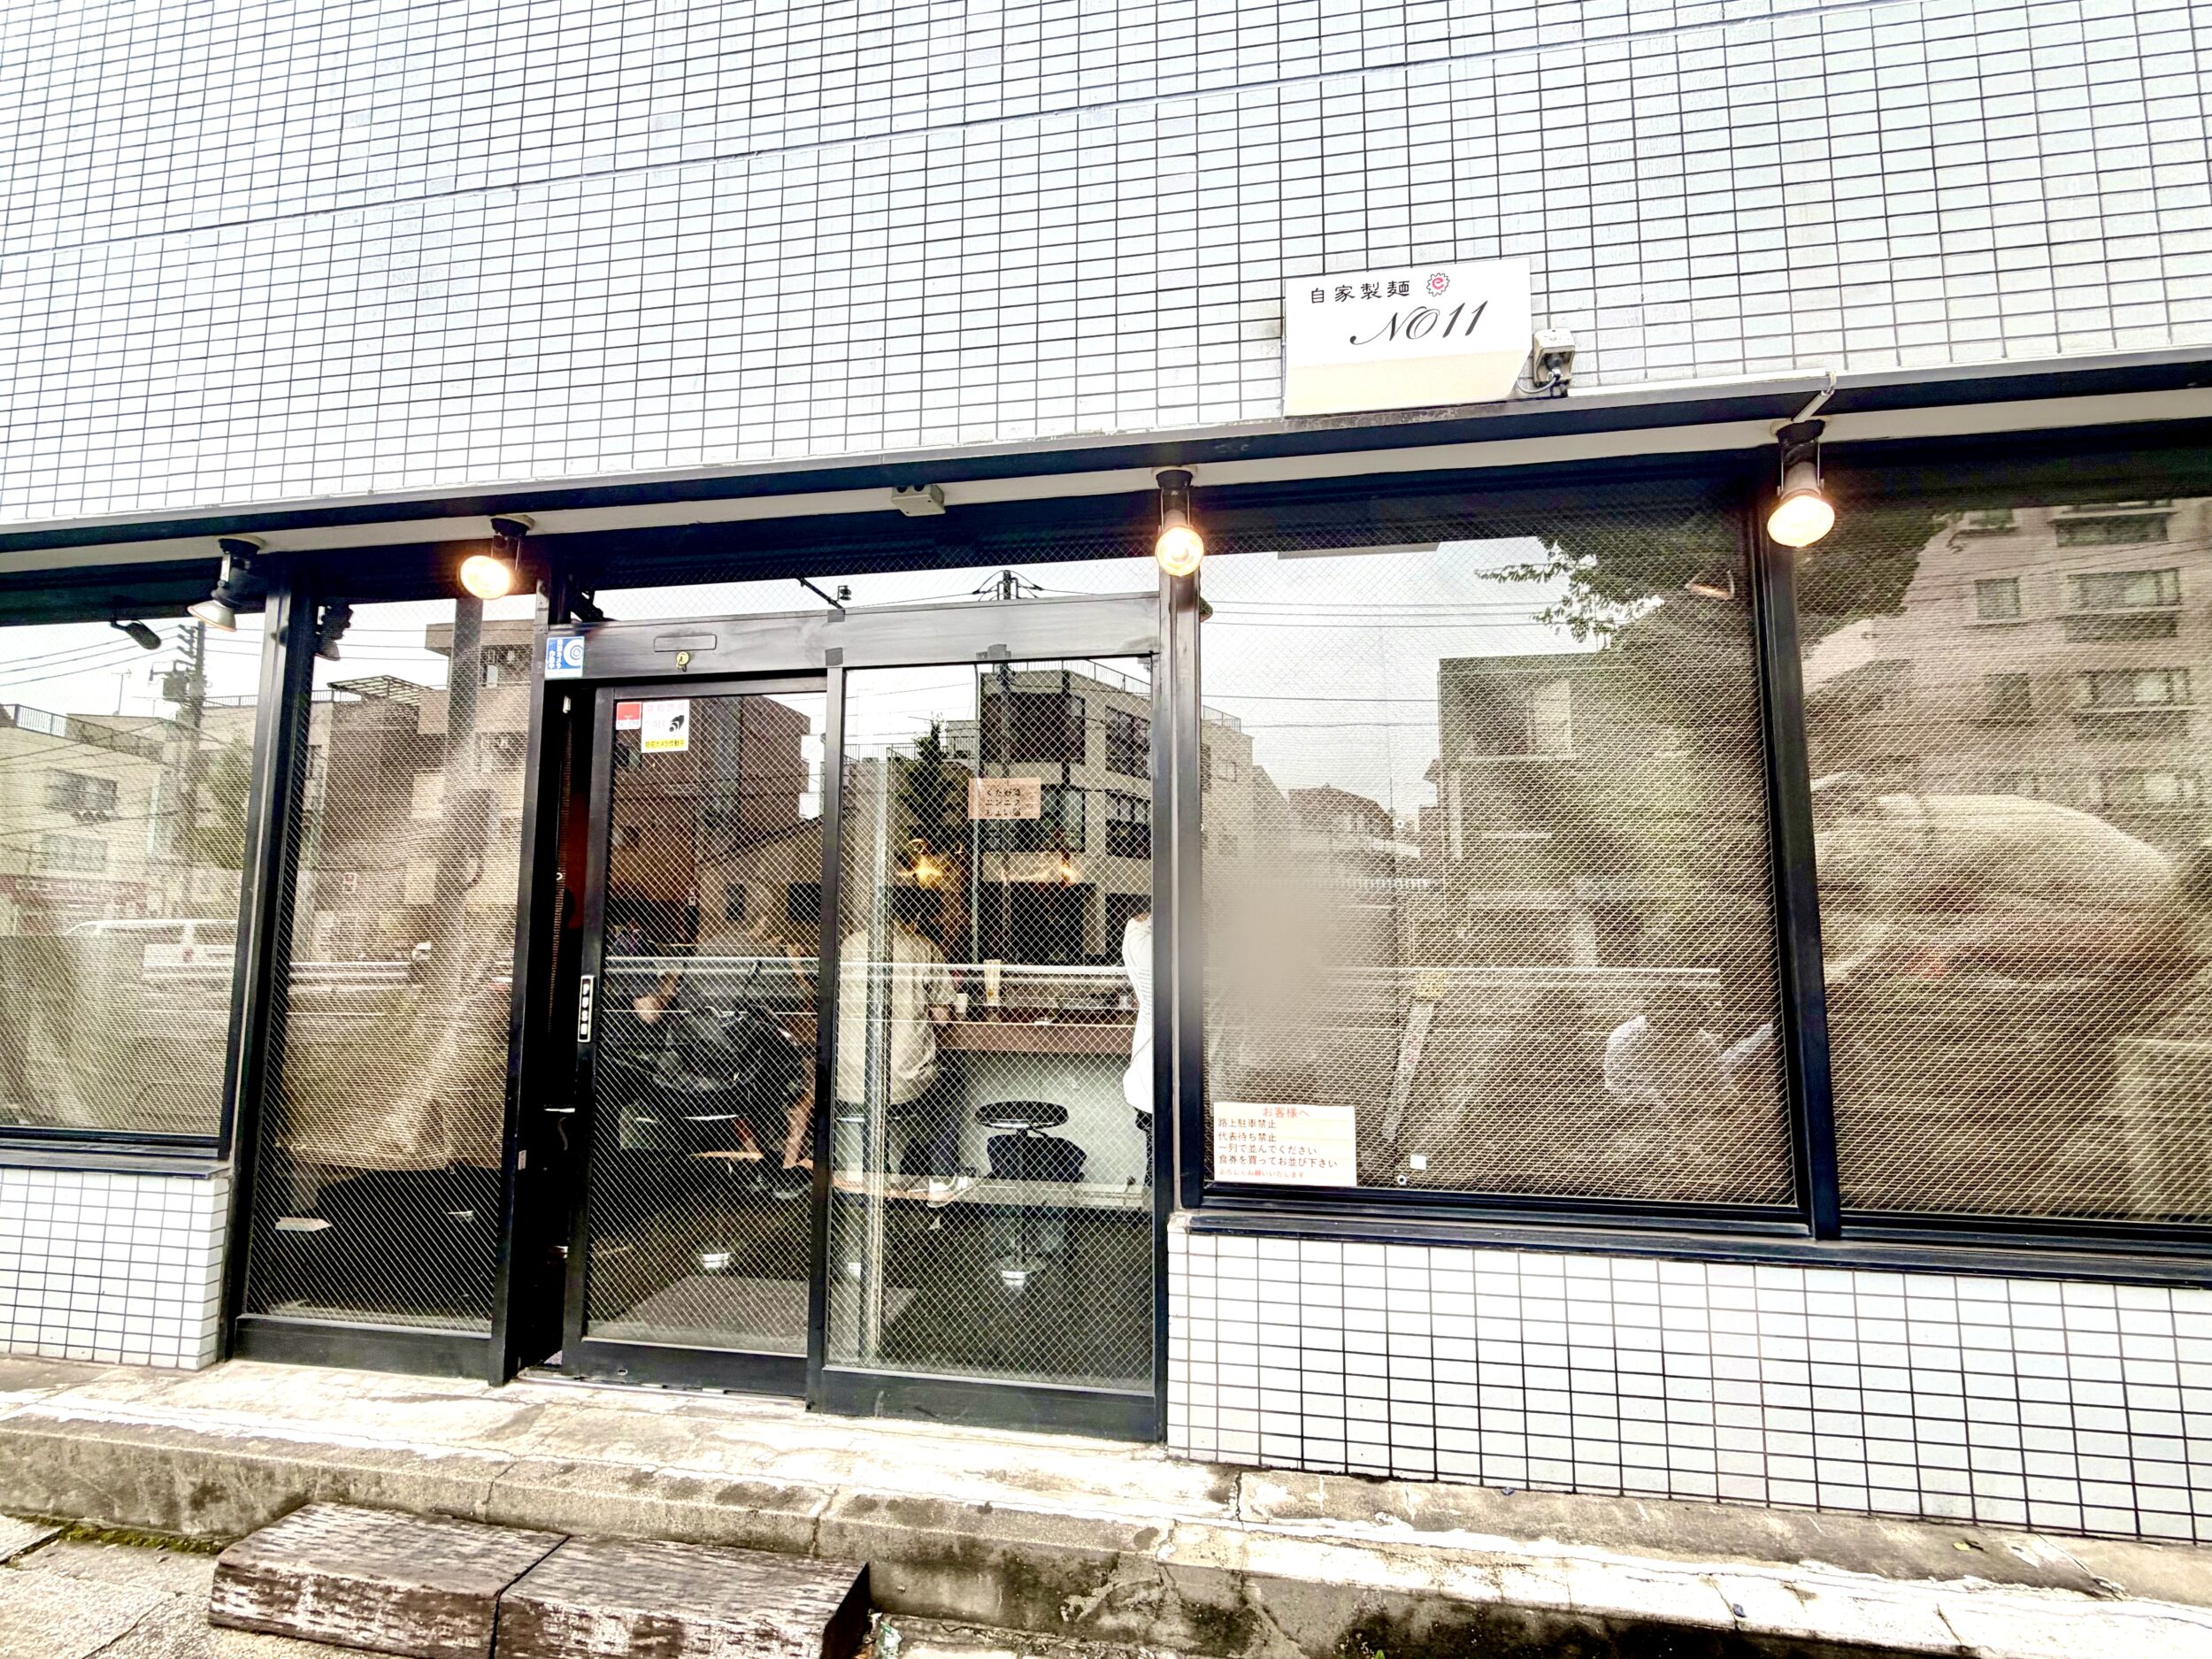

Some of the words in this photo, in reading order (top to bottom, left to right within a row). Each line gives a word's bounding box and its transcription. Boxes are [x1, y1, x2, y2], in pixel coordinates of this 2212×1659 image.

[1310, 280, 1410, 303] 自家製麺
[1263, 1106, 1310, 1118] お客様へ
[1217, 1118, 1277, 1129] 路上駐車禁止
[1217, 1132, 1277, 1143] 代表待ち禁止
[1218, 1143, 1317, 1155] 一列で並んでください
[1218, 1154, 1338, 1168] 食券を買ってお並び下さい
